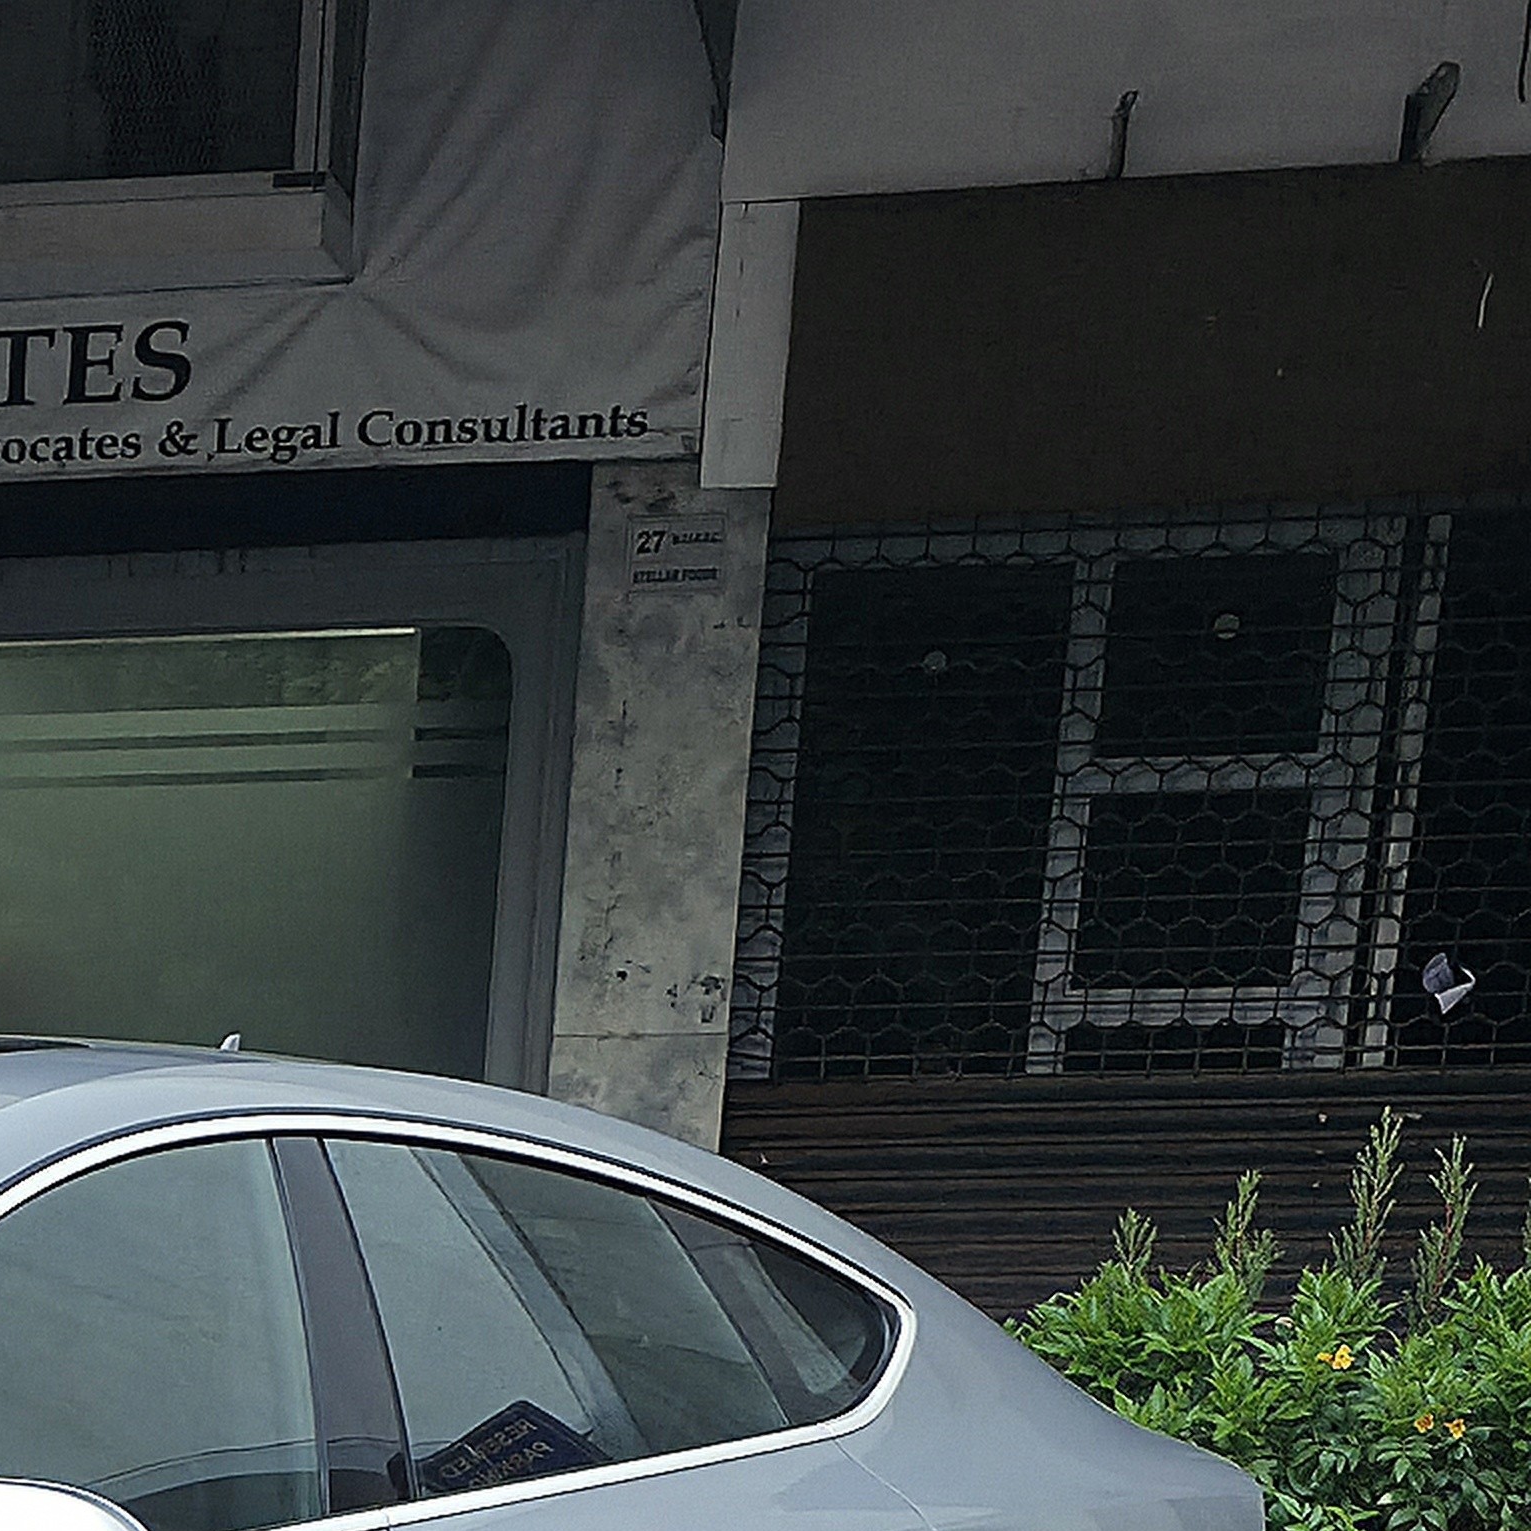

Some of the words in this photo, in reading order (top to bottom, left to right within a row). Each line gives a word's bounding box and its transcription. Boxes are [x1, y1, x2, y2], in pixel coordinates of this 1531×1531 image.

[157, 420, 200, 458] &
[211, 410, 341, 465] Legal
[356, 402, 651, 450] Consultants
[635, 529, 668, 556] 27
